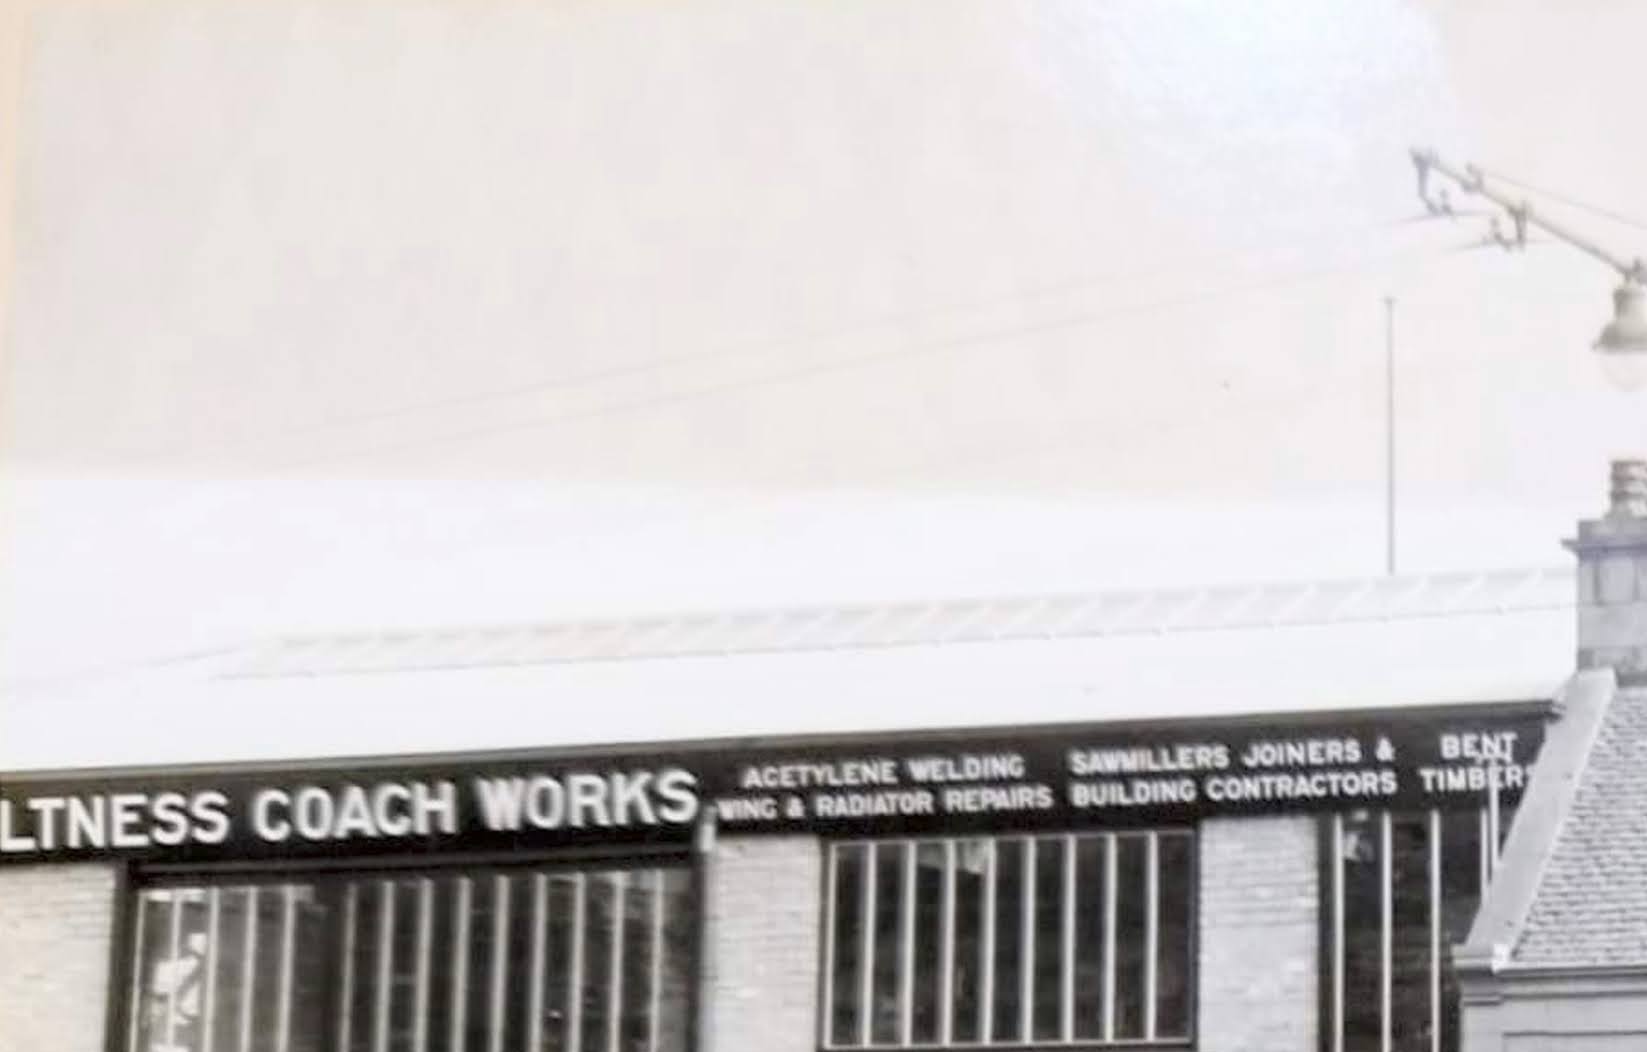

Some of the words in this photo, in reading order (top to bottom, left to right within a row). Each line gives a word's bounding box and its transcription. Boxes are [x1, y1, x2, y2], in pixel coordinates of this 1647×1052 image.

[1070, 745, 1230, 775] SAWMILLERS
[1243, 739, 1362, 769] JOINERS
[1374, 737, 1396, 763] &
[1441, 731, 1518, 760] BENT
[743, 760, 898, 788] ACETYLENE
[907, 754, 1025, 783] WELDING
[1071, 778, 1198, 807] BUILDING
[1205, 768, 1398, 800] CONTRACTORS
[0, 790, 230, 852] LTNESS
[252, 780, 457, 842] COACH
[475, 766, 699, 831] WORKS
[716, 798, 778, 821] WING
[787, 796, 804, 819] &
[816, 790, 934, 818] RADIATOR
[945, 785, 1053, 813] REPAIRS
